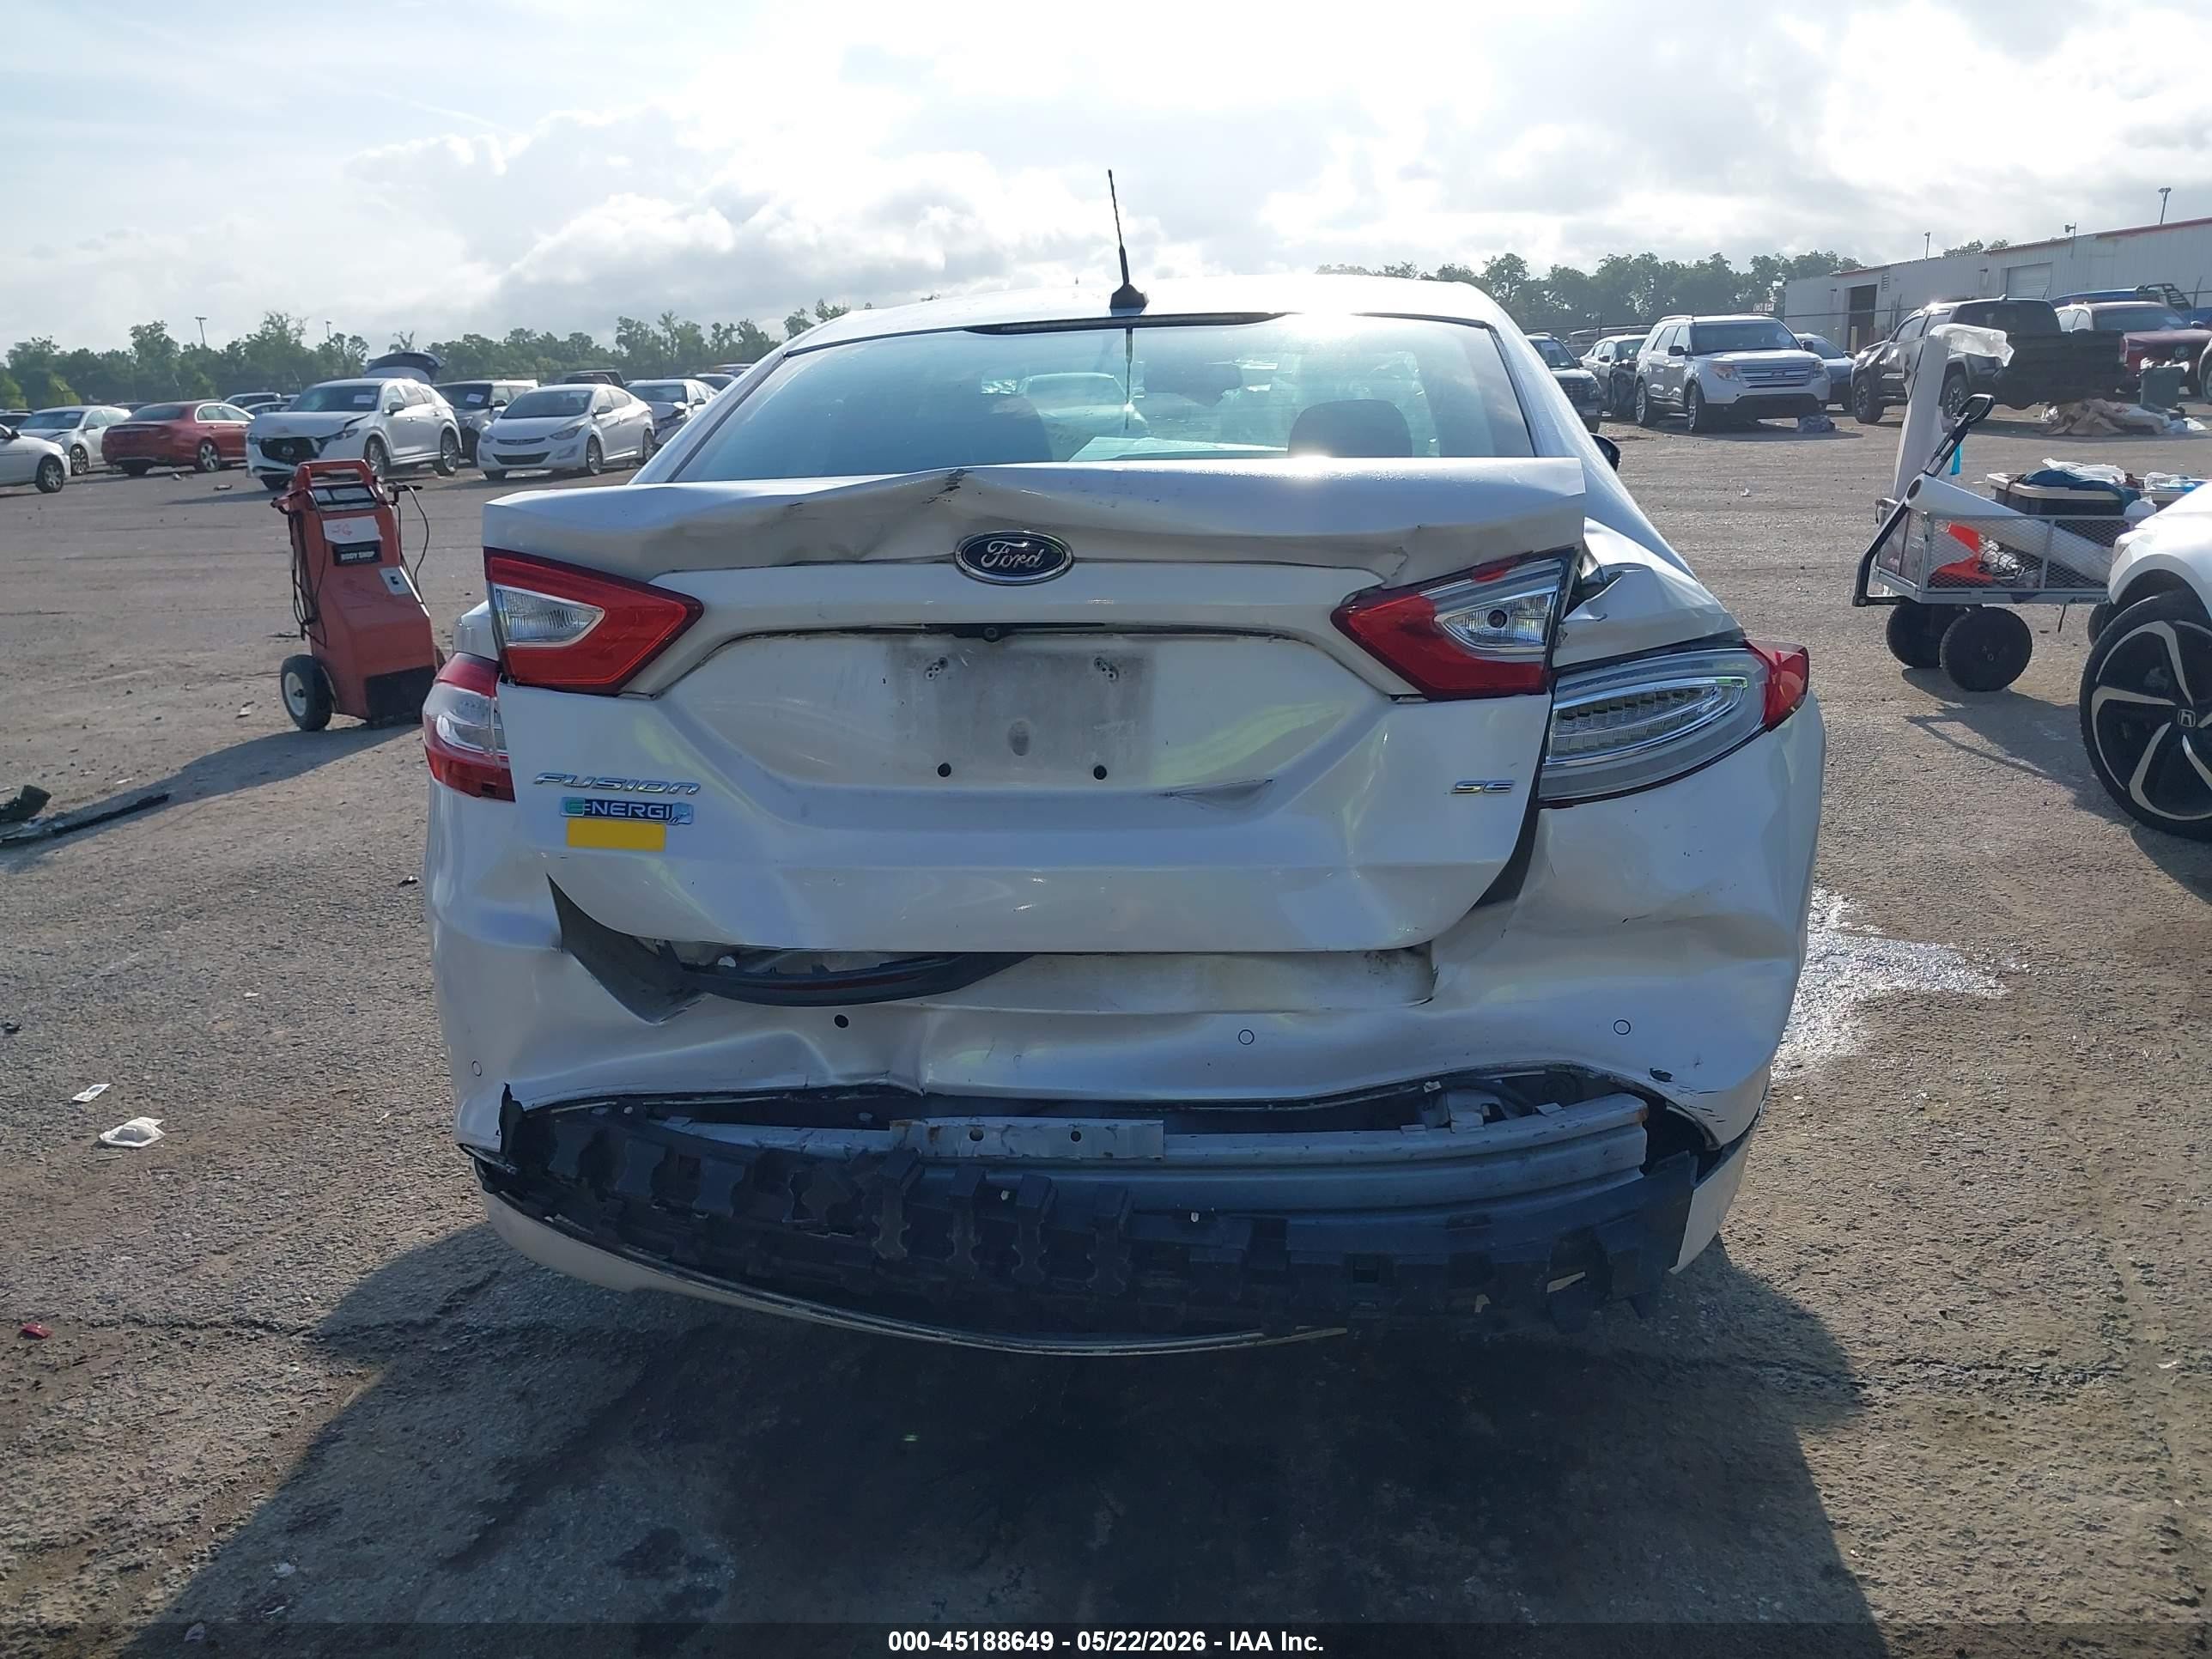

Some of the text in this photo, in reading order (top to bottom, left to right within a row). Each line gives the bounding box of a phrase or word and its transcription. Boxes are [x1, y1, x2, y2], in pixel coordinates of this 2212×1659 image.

[981, 540, 1045, 568] Ford
[533, 772, 701, 795] FUSION
[1451, 780, 1515, 793] SE
[566, 798, 671, 819] ENERGI
